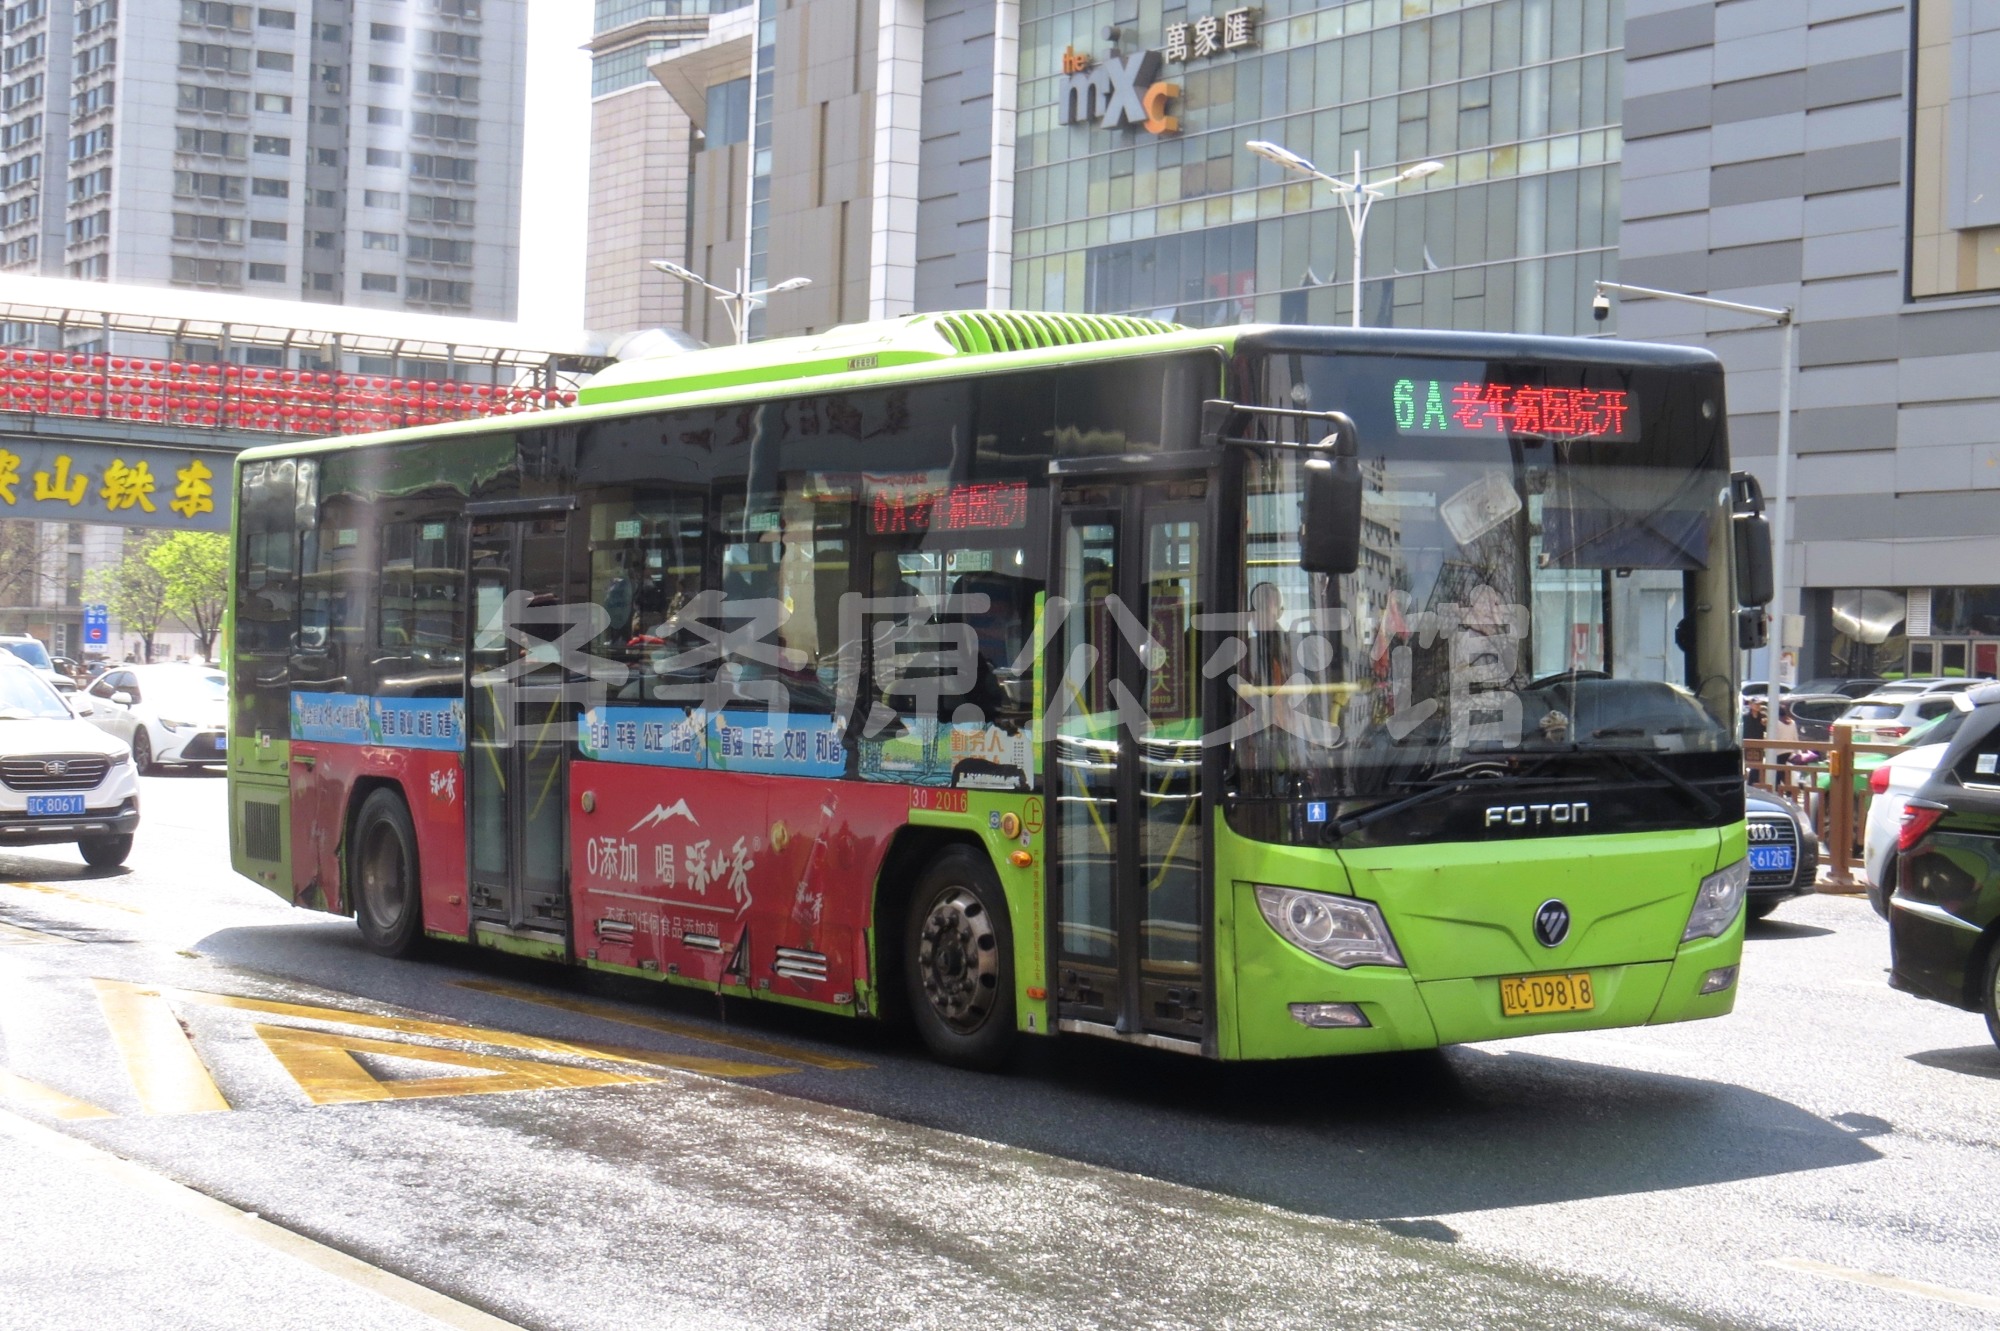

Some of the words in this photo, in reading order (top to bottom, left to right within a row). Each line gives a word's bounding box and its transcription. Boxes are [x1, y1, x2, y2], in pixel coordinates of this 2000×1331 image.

[1165, 7, 1249, 64] 萬象匯
[1062, 44, 1086, 74] the
[381, 710, 395, 735] 爱国
[418, 711, 432, 736] 诚信
[437, 711, 451, 737] 友善
[591, 724, 609, 749] 自由
[616, 723, 636, 750] 平等
[643, 724, 663, 751] 公正
[670, 724, 691, 752] 法治
[720, 727, 743, 757] 富强
[752, 728, 775, 758] 民主
[783, 730, 807, 761] 文明
[815, 732, 841, 763] 和谐
[912, 788, 928, 808] 30
[935, 791, 967, 812] 2016
[1485, 803, 1589, 827] FOTON
[587, 835, 638, 882] 0添加
[655, 843, 676, 889] 喝
